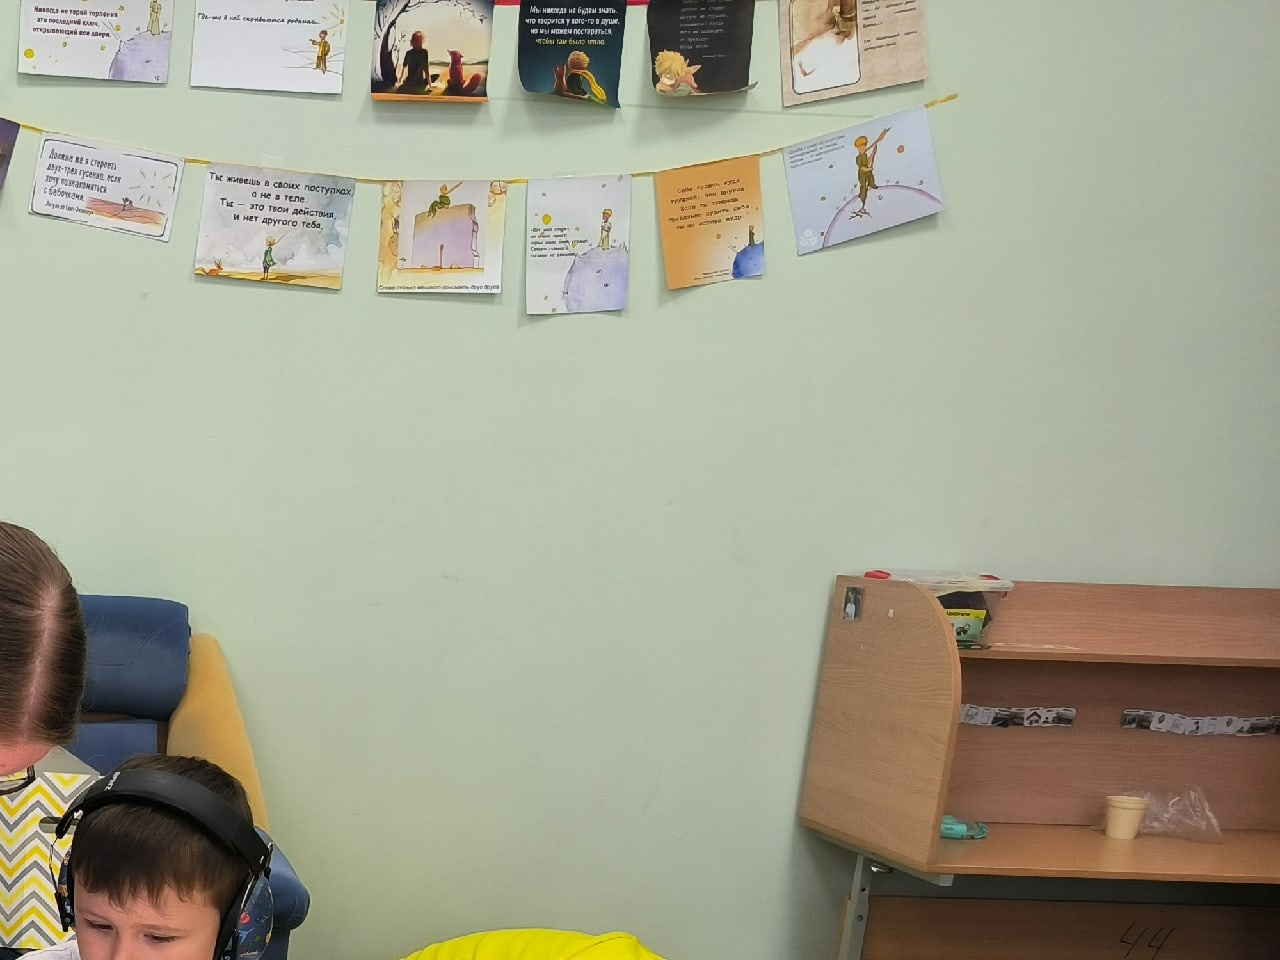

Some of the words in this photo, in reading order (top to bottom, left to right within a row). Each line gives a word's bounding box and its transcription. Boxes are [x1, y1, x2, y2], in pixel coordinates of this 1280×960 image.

[530, 5, 541, 14] Мы
[543, 7, 567, 15] никогда
[578, 6, 597, 15] будем
[49, 18, 81, 26] последний
[538, 18, 565, 26] творится
[33, 27, 77, 36] открывающий
[535, 37, 555, 45] чтобы
[569, 37, 586, 45] было
[75, 156, 84, 164] же
[90, 158, 117, 171] стерпеть
[46, 163, 78, 177] двух-трех
[106, 174, 122, 184] если
[44, 175, 60, 187] хочу
[60, 178, 107, 194] познакомиться
[209, 171, 223, 182] Ты
[226, 175, 261, 186] живешь
[273, 181, 301, 190] своих
[304, 184, 354, 198] поступках,
[260, 192, 271, 200] не
[220, 197, 234, 208] Ты
[249, 202, 265, 211] это
[268, 205, 289, 214] твои
[292, 206, 337, 221] действия,
[243, 214, 259, 222] нет
[261, 216, 298, 228] другого
